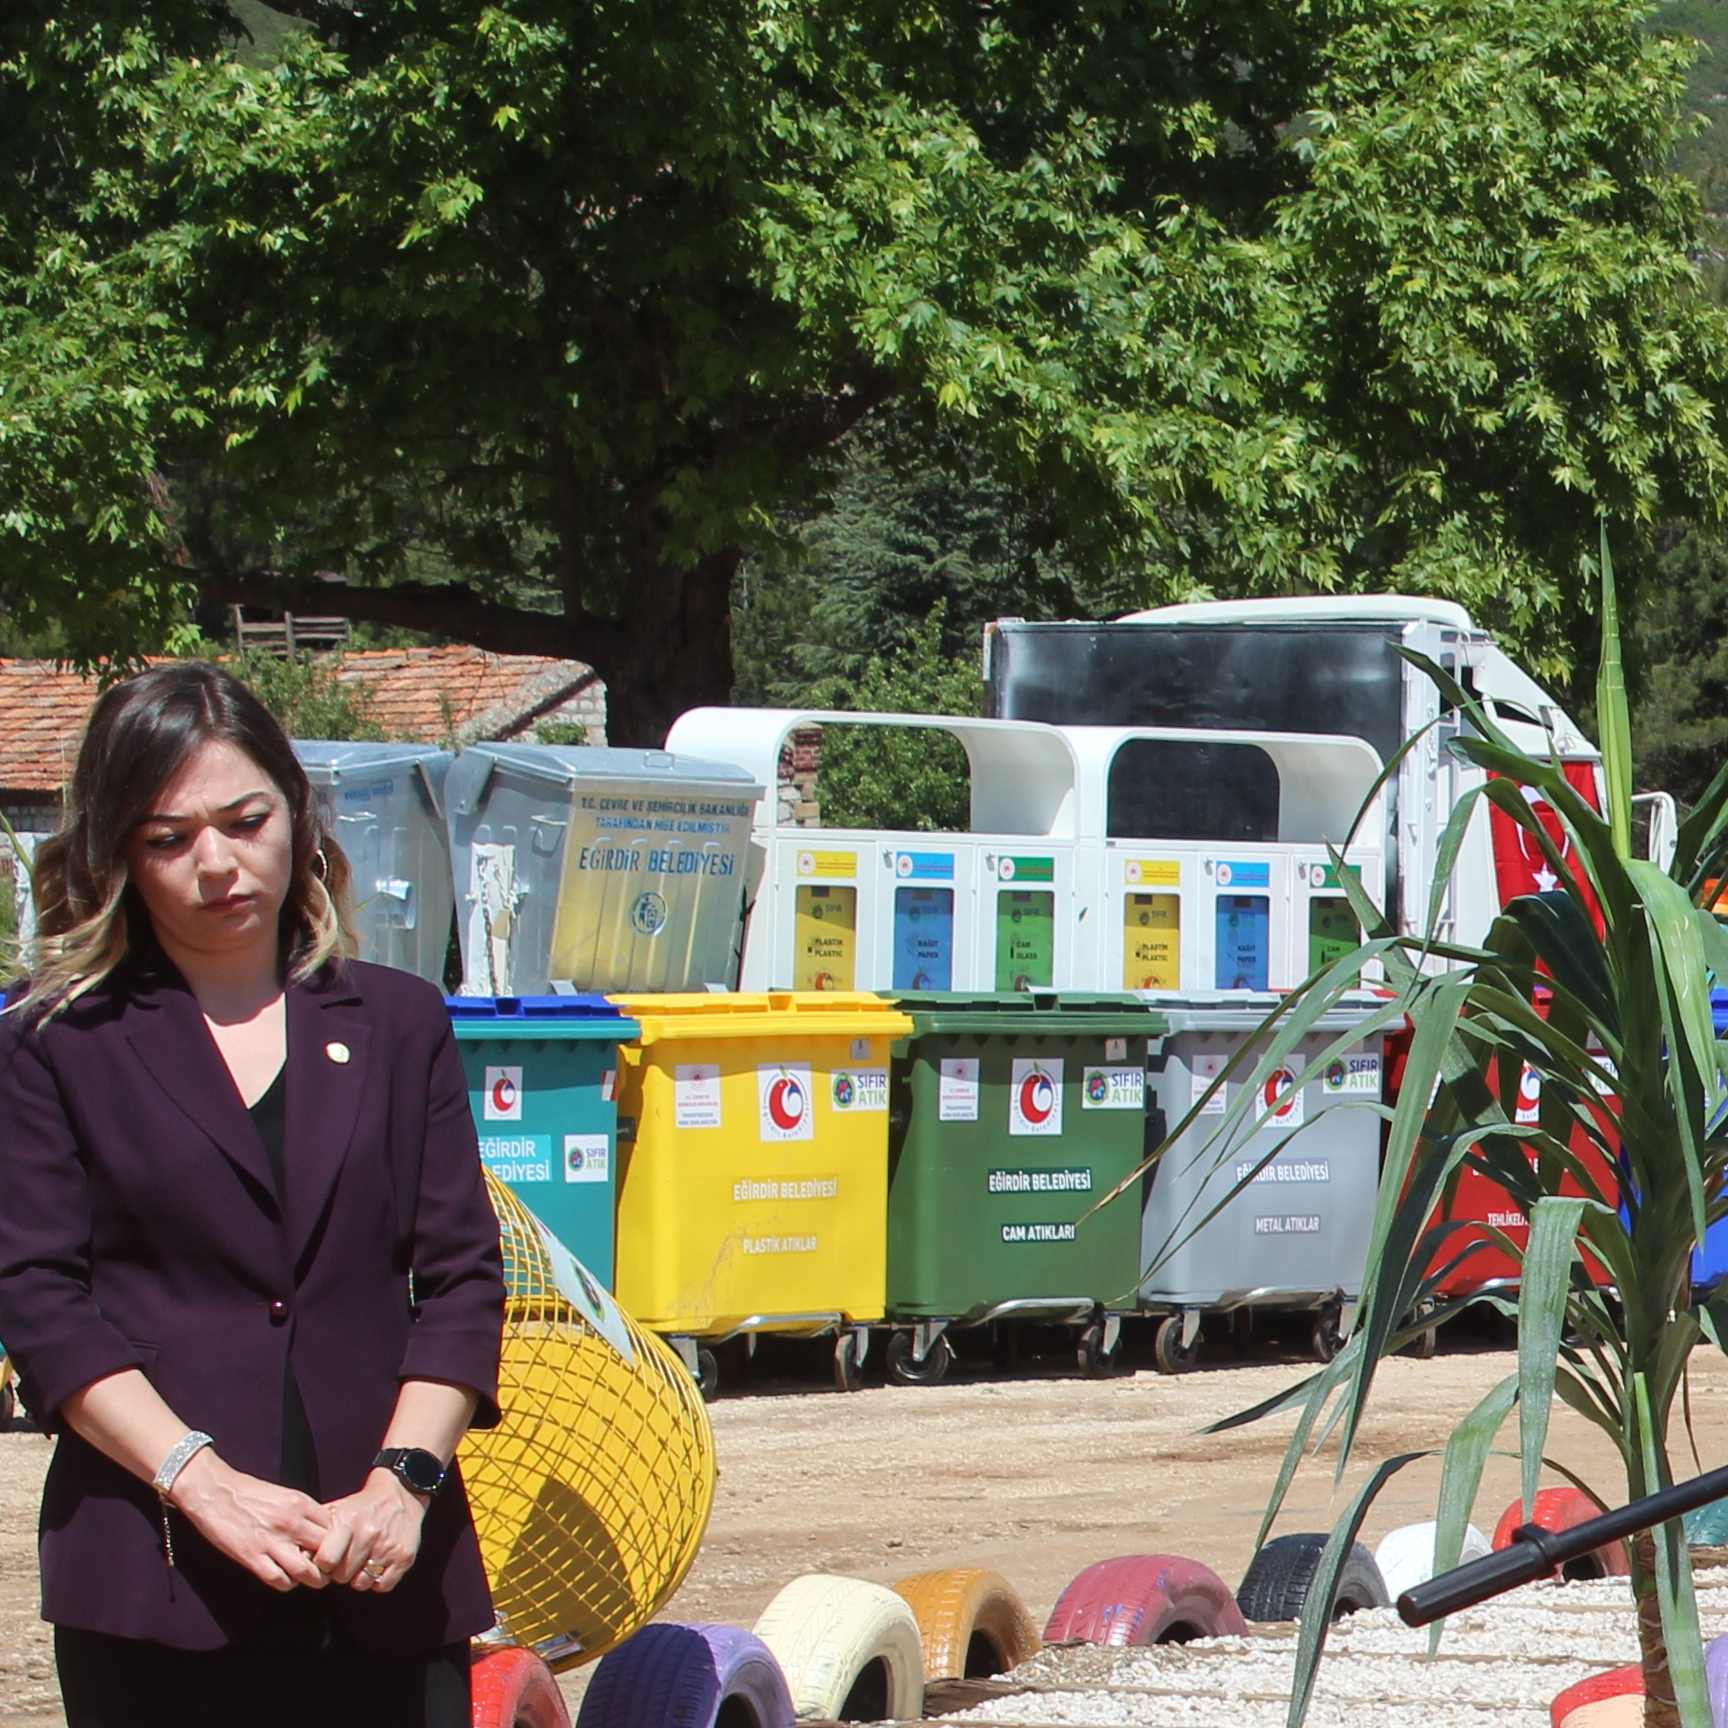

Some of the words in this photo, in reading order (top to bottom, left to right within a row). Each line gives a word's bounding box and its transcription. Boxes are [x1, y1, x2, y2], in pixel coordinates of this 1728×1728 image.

[600, 799, 628, 812] ÇEVRE
[632, 801, 643, 811] VE
[596, 817, 651, 830] TARAFINDAN
[1349, 1059, 1378, 1073] SIFIR
[858, 1073, 886, 1089] SIFIR
[1112, 1073, 1143, 1088] SIFIR
[1349, 1074, 1377, 1088] ATIK
[858, 1090, 887, 1106] ATIK
[1112, 1088, 1142, 1103] ATIK
[586, 1147, 607, 1158] SIFIR
[587, 1159, 606, 1169] ATIK
[1277, 1161, 1329, 1181] BELEDİYESİ
[989, 1170, 1030, 1192] EĞİRDİR
[1032, 1168, 1091, 1191] BELEDİYESİ
[733, 1179, 779, 1201] EĞİRDİR
[781, 1177, 837, 1199] BELEDİYESİ
[1003, 1226, 1026, 1241] CAM
[1028, 1224, 1075, 1240] ATIKLARI
[1255, 1218, 1285, 1233] METAL
[1285, 1217, 1320, 1231] ATIKLAR
[743, 1236, 780, 1254] PLASTİK
[782, 1236, 818, 1252] ATIKLAR
